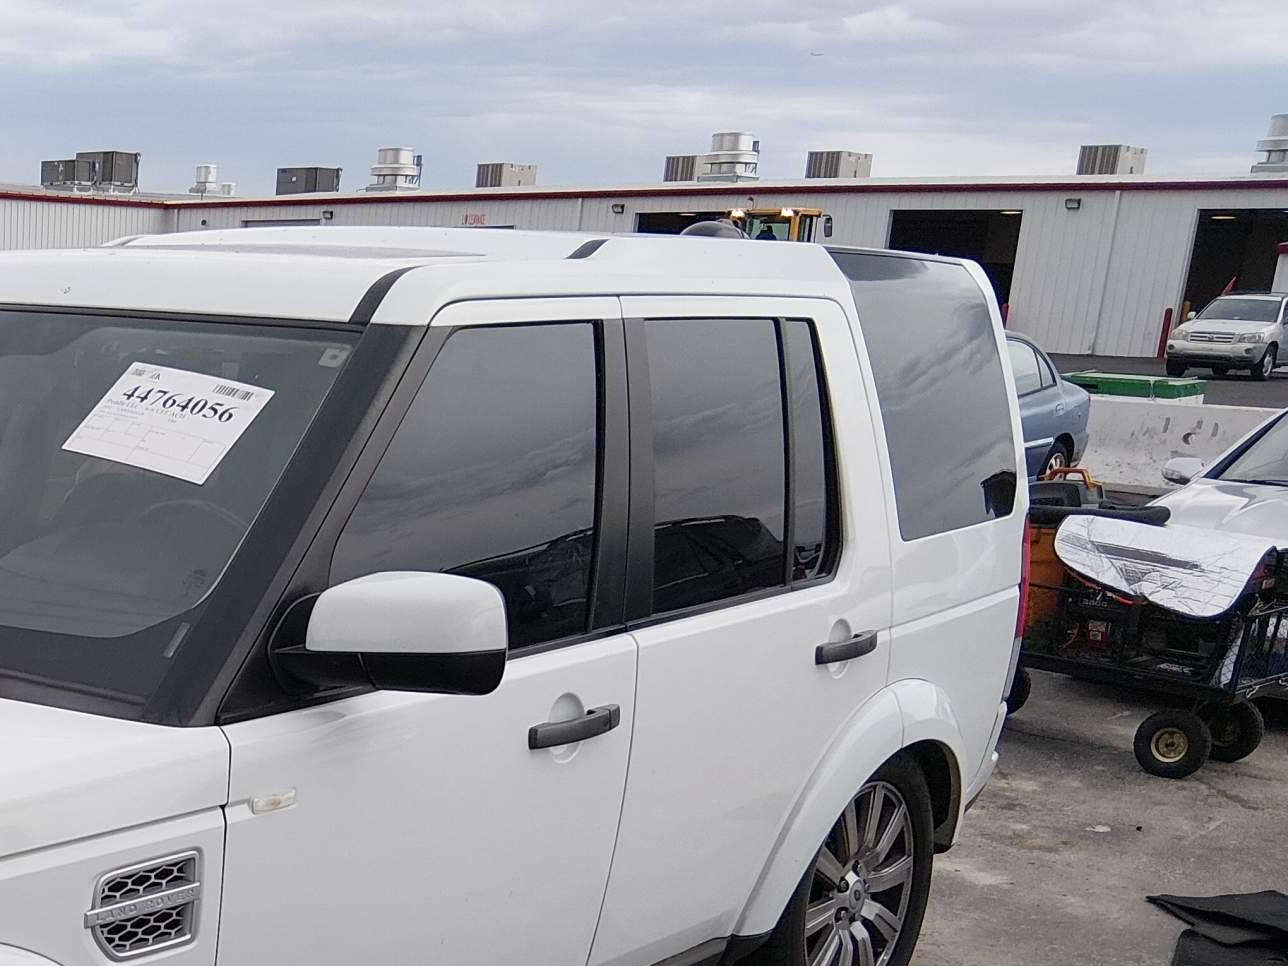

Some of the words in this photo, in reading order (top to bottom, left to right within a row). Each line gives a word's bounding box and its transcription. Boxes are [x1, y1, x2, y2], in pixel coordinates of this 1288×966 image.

[123, 384, 240, 422] 44764056
[96, 903, 138, 922] LAND
[143, 888, 196, 912] ROVER
